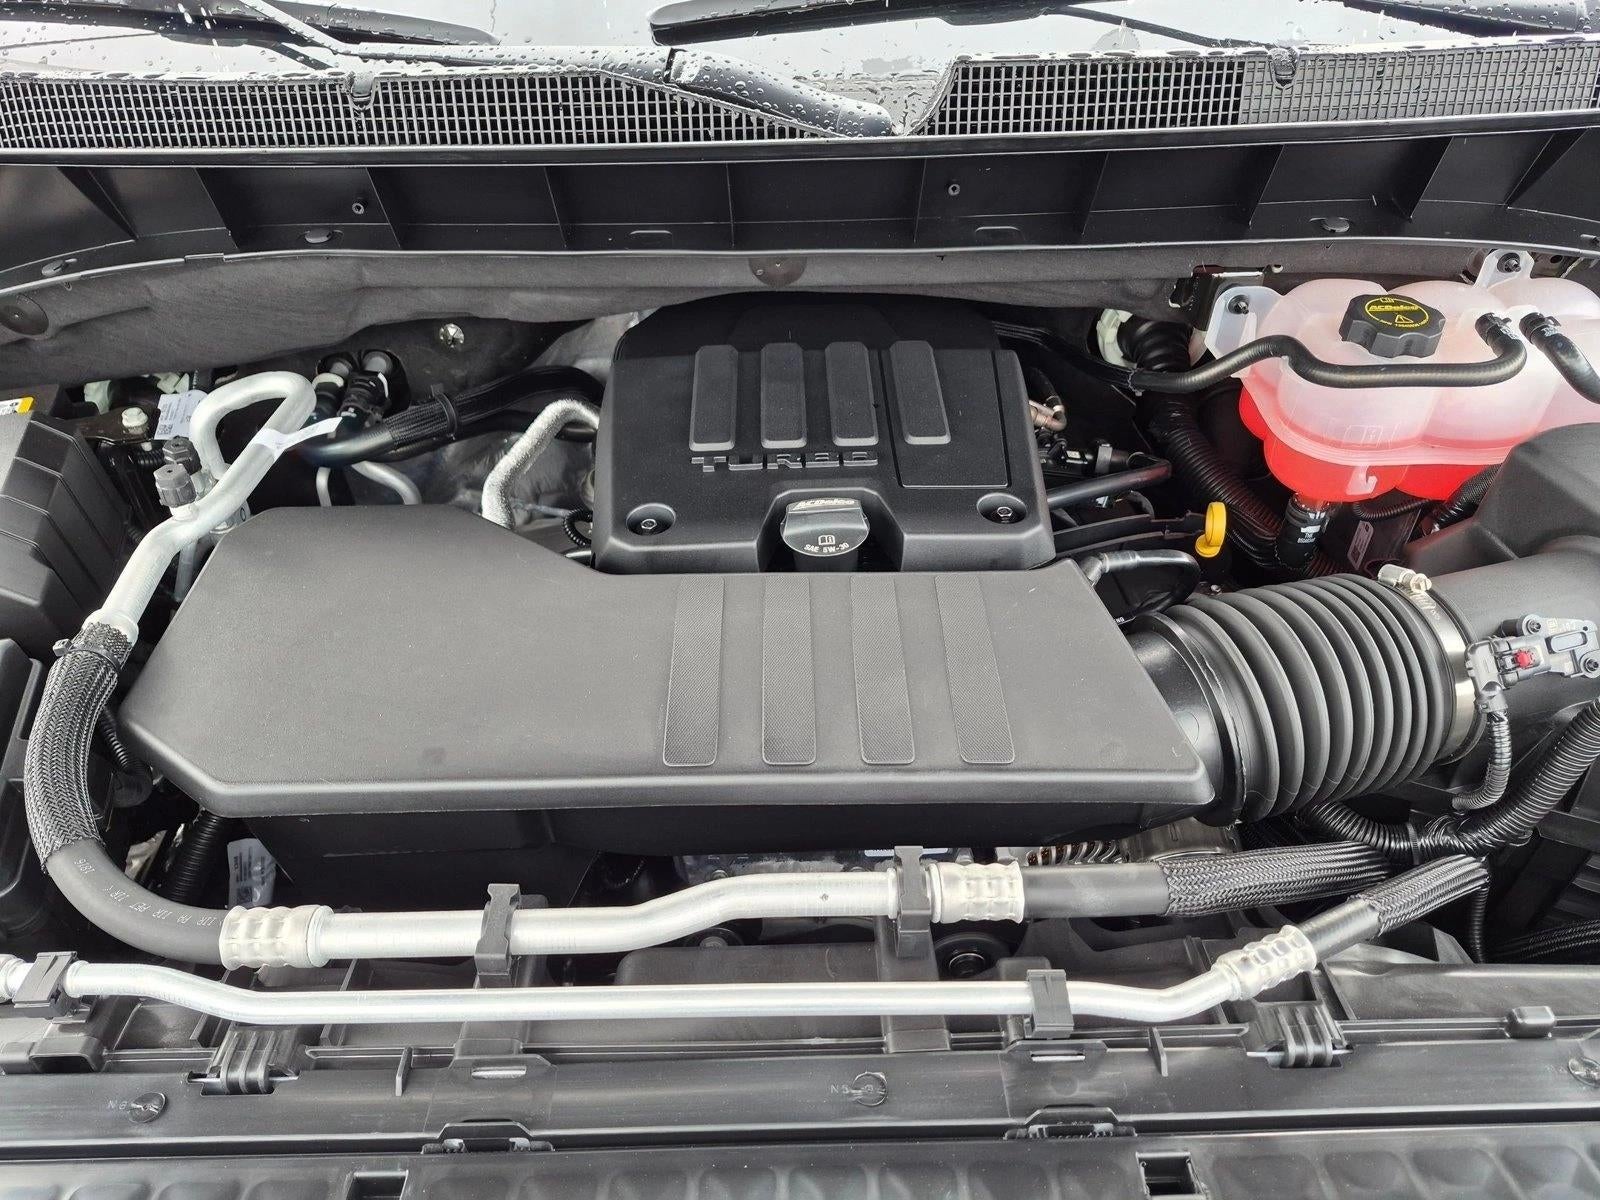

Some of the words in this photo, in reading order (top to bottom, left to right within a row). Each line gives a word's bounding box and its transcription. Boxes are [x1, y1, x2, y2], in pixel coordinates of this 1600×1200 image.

[691, 451, 879, 473] TURBO
[803, 543, 820, 553] SAE
[822, 542, 850, 553] 5W-30
